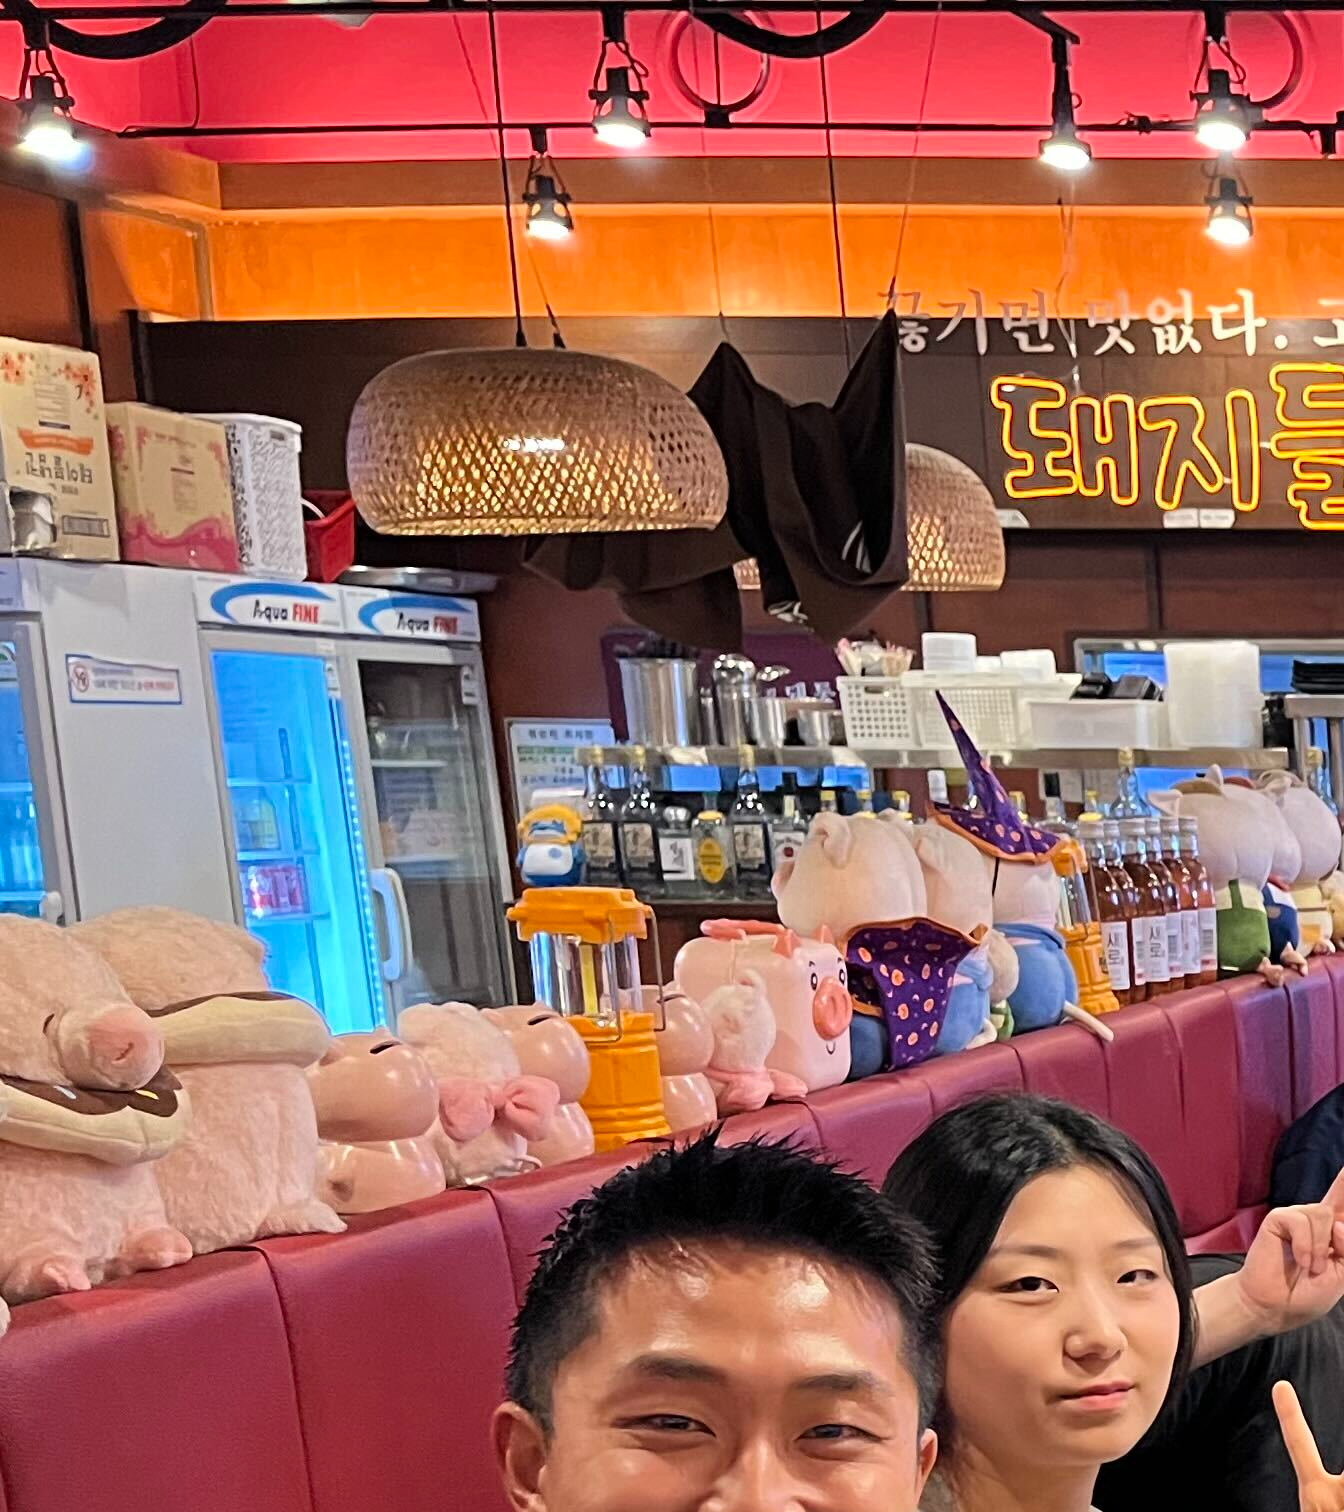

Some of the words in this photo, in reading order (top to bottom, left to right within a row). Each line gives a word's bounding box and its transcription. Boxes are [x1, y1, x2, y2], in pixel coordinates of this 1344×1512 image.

[1085, 287, 1289, 357] 맛없다.
[252, 599, 287, 623] Aqua
[292, 603, 320, 624] FINE
[1107, 932, 1124, 965] 새로
[1149, 927, 1165, 959] 새로
